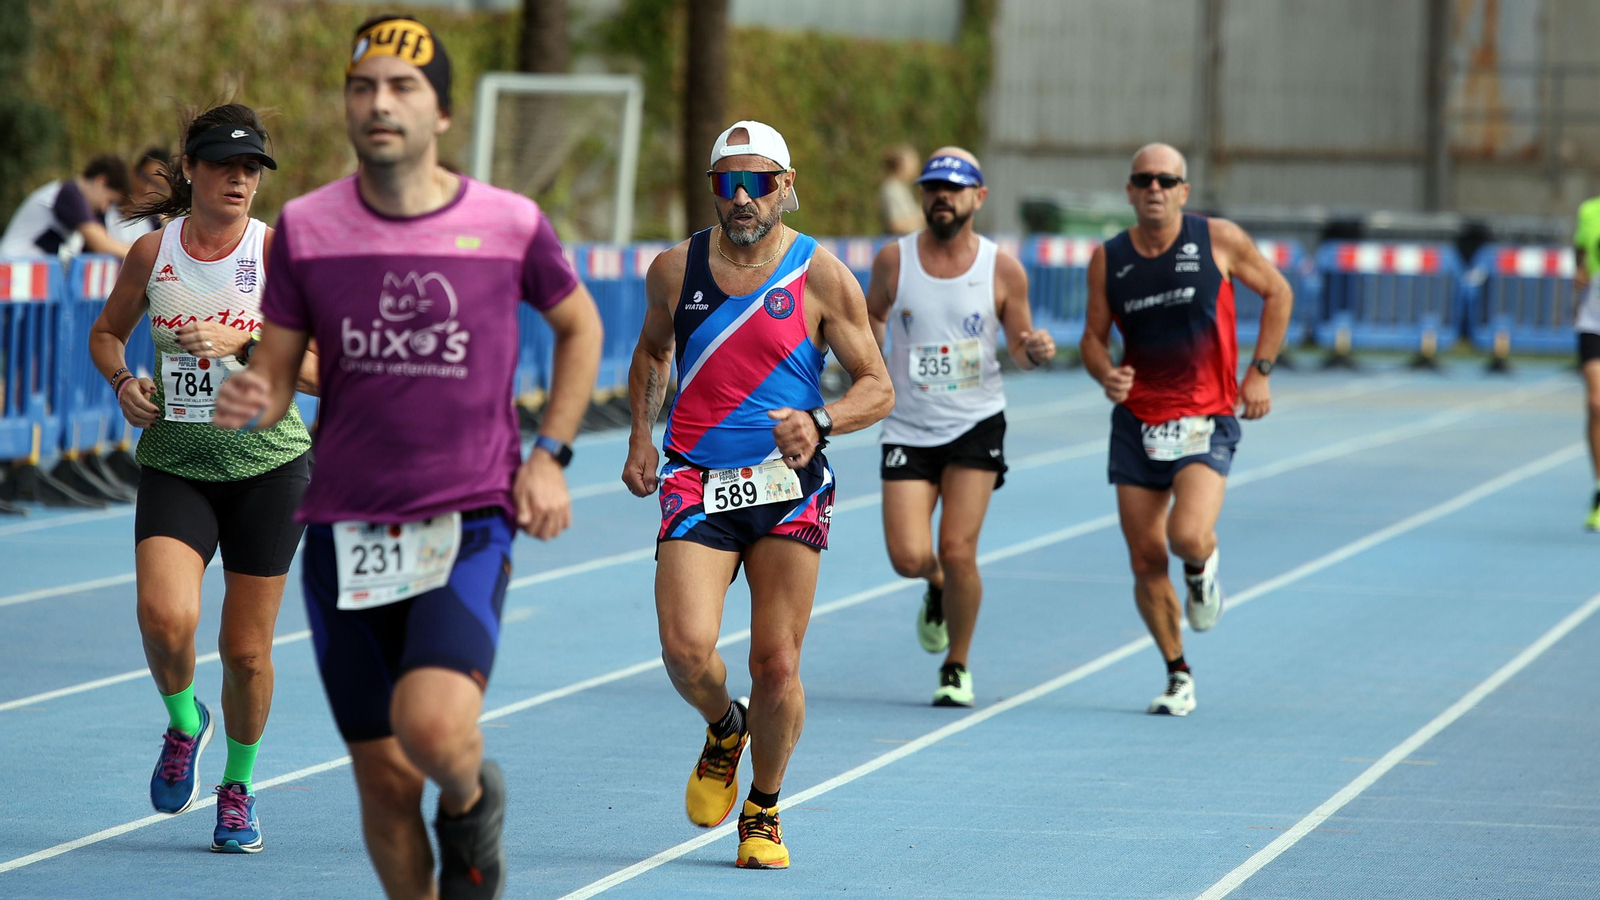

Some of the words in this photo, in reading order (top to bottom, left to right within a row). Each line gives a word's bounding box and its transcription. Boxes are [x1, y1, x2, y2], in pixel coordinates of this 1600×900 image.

[684, 303, 709, 311] VIATOR
[152, 309, 263, 332] martón
[918, 356, 950, 376] 535
[171, 372, 213, 397] 784
[715, 480, 758, 510] 589
[351, 542, 403, 576] 231
